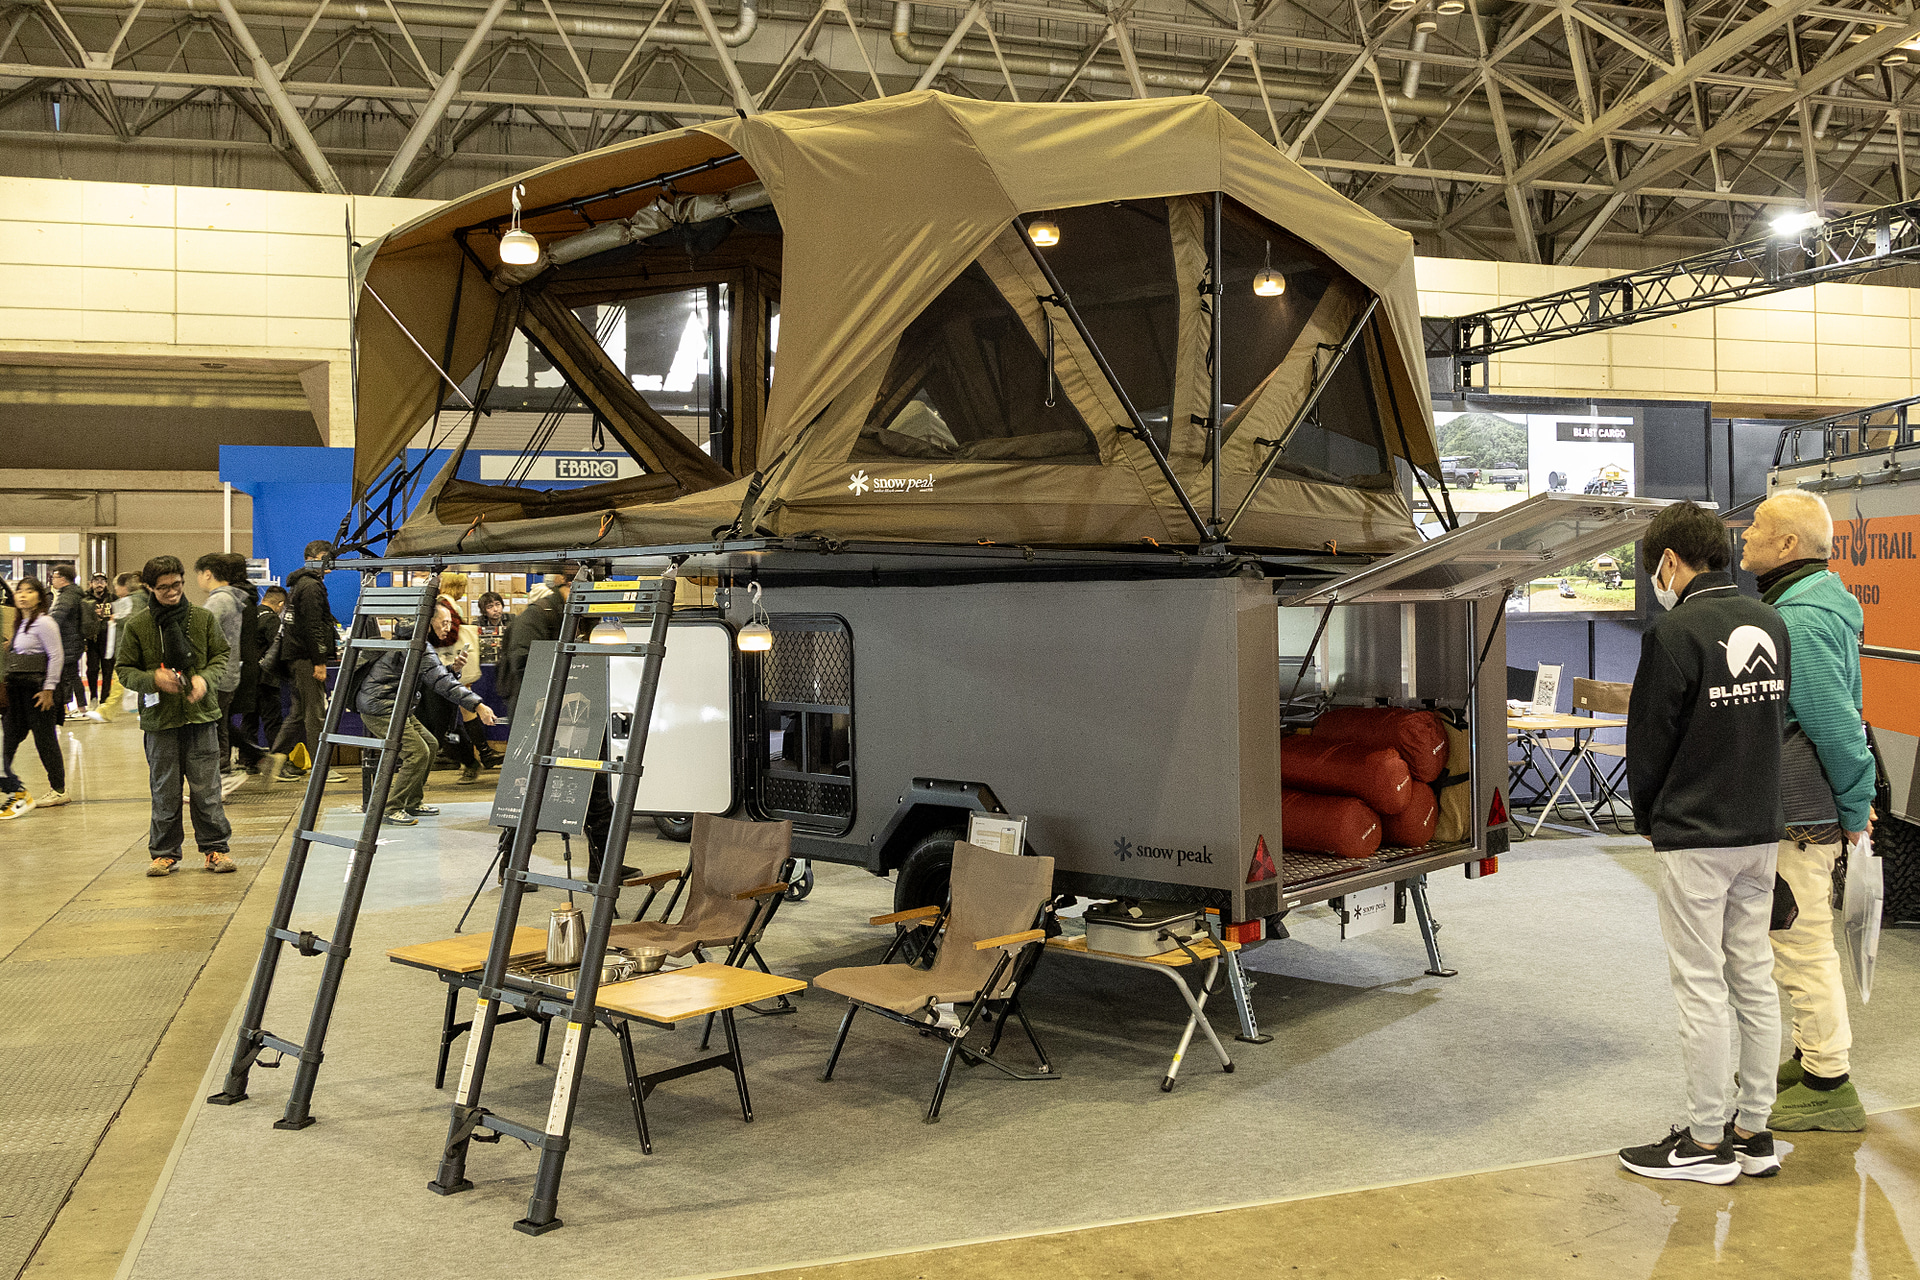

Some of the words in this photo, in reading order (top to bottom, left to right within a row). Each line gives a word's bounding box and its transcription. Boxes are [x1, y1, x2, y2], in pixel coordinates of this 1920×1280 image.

[1573, 427, 1598, 438] BLAST
[1598, 428, 1626, 439] CARGO
[558, 460, 616, 477] EBBRO
[873, 478, 906, 489] snow
[905, 473, 937, 493] peak
[1868, 532, 1917, 560] TRAIL
[1709, 681, 1758, 699] BLAST
[1136, 845, 1174, 860] snow
[1177, 845, 1214, 867] peak
